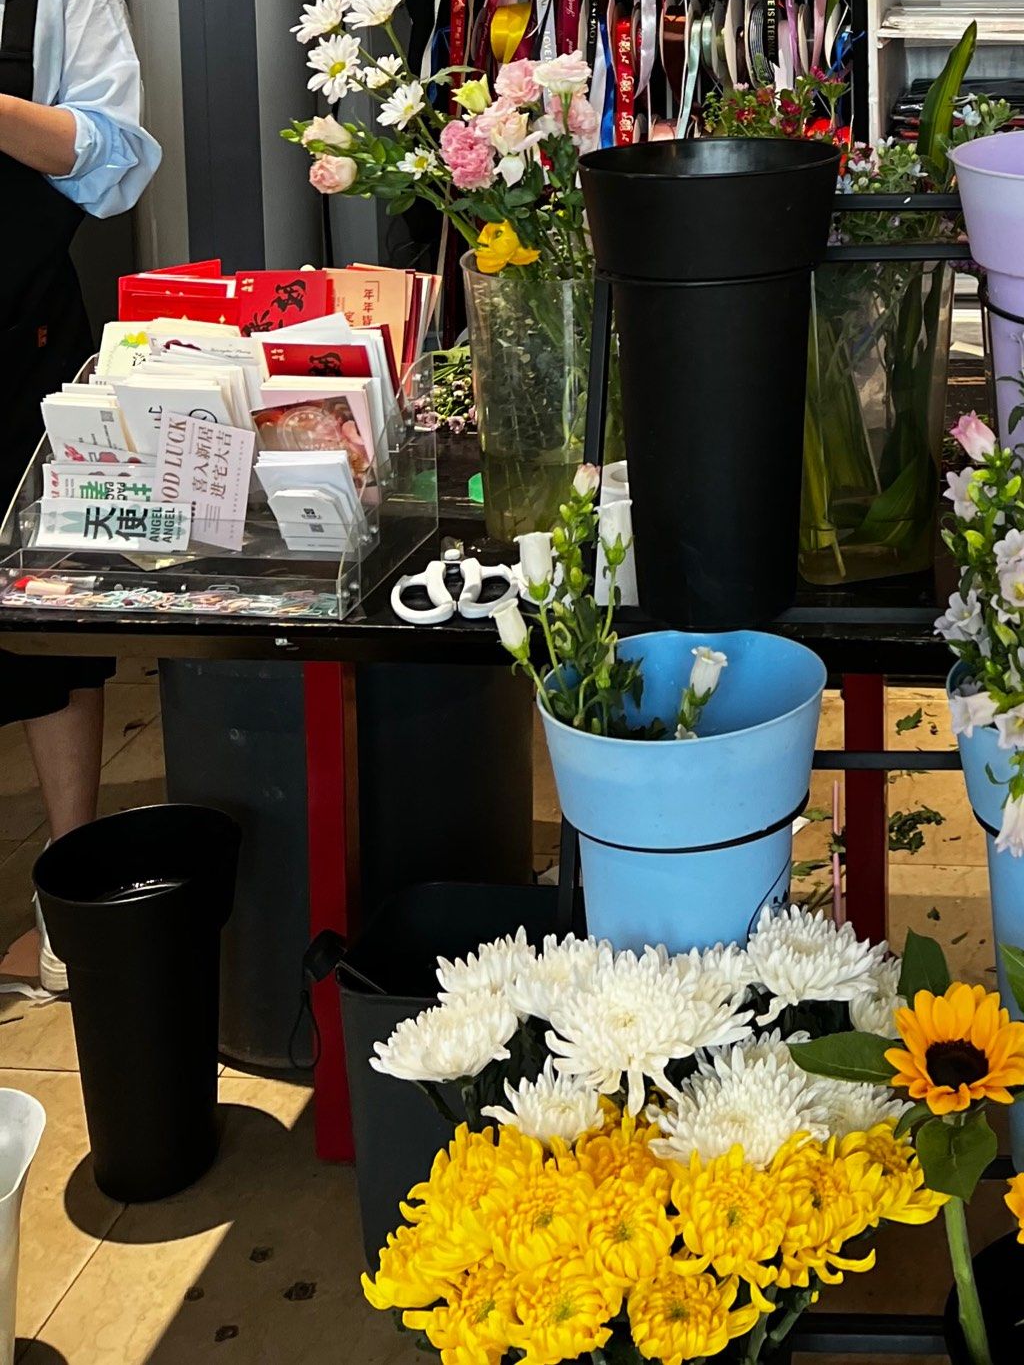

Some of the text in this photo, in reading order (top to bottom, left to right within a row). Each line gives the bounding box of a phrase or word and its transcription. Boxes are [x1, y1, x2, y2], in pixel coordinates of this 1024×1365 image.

[767, 8, 776, 16] IS
[767, 17, 776, 57] ETERNAL
[165, 418, 188, 468] LUCK
[192, 426, 214, 493] 喜入新居
[210, 431, 232, 500] 进宅大吉
[83, 506, 149, 541] 天使
[149, 507, 162, 543] ANGEL
[162, 507, 176, 544] ANGEL
